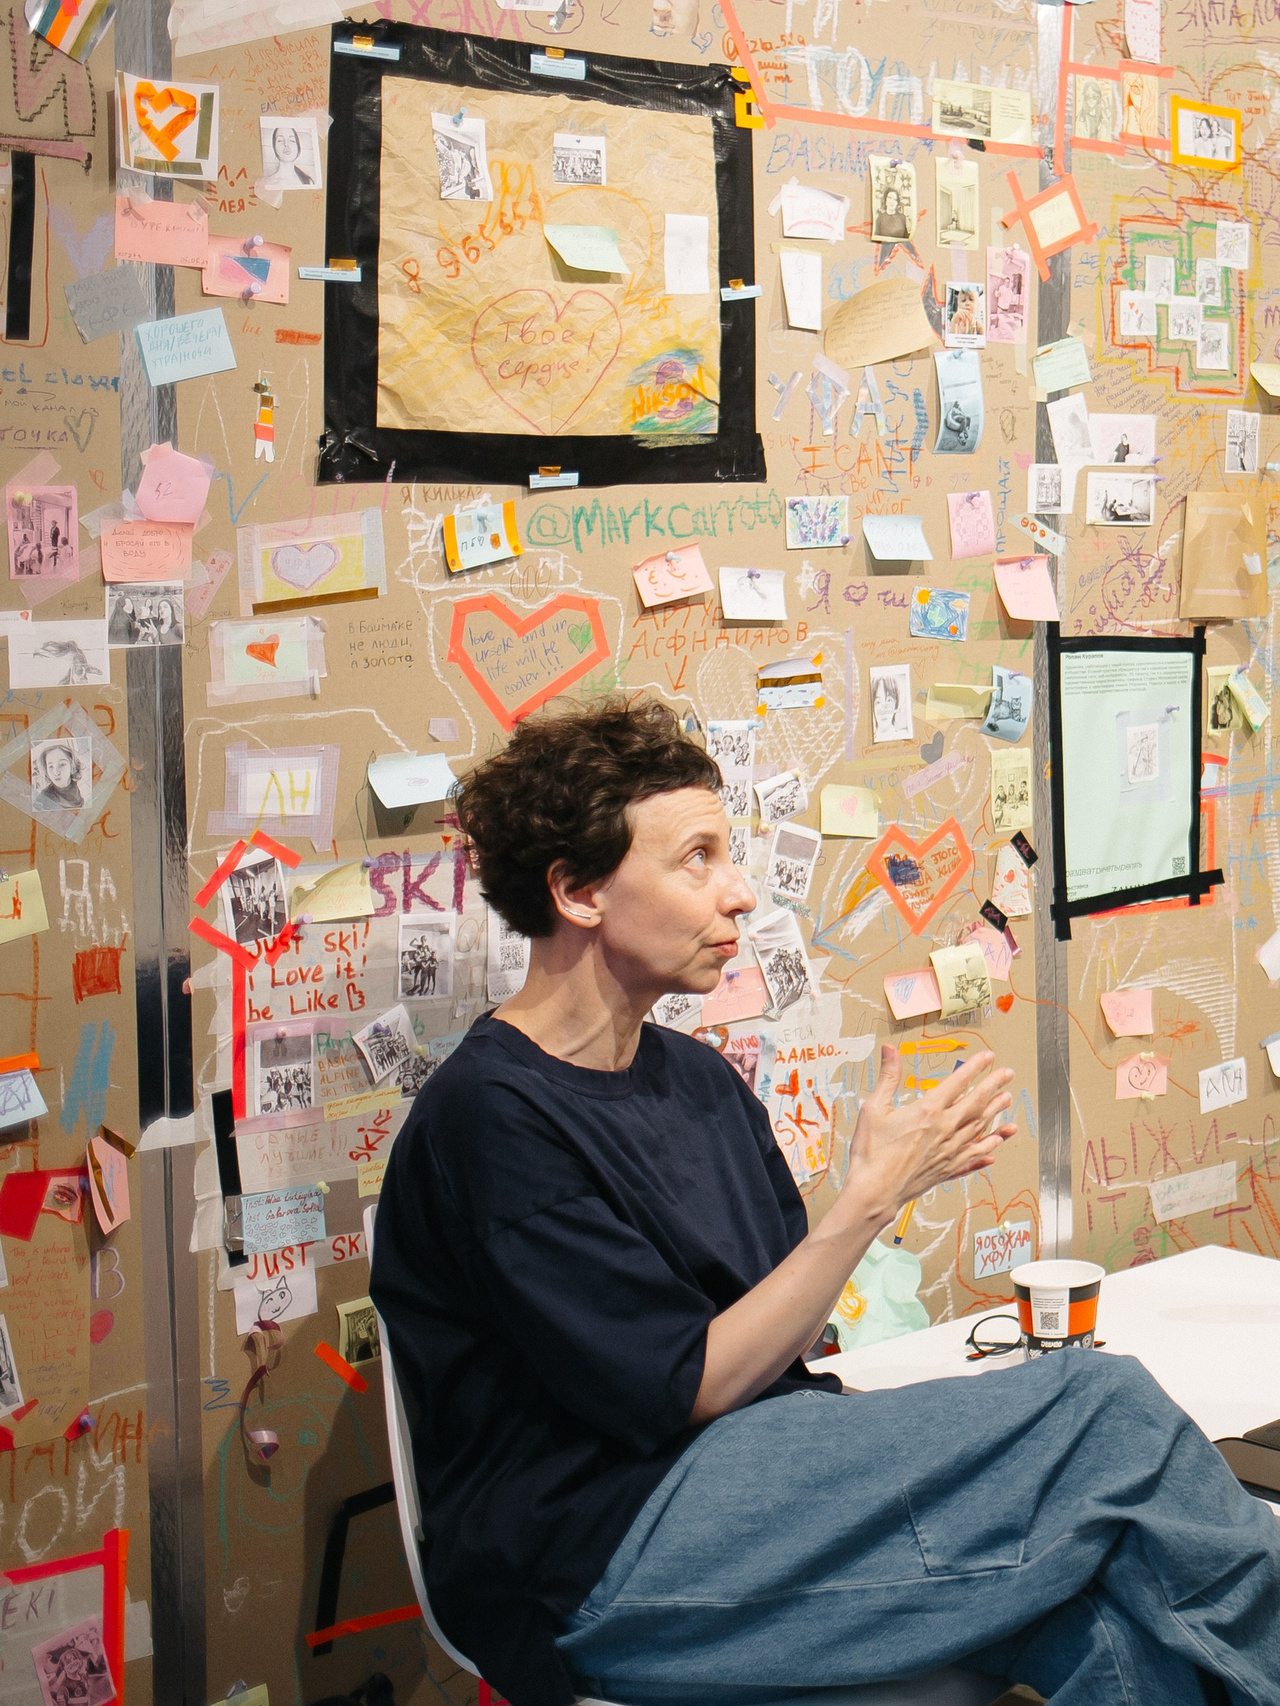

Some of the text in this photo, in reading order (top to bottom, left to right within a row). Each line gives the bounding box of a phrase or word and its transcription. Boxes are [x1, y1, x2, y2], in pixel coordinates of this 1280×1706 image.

[219, 198, 246, 213] ЛЕЯ
[146, 318, 205, 342] ХОРОШЕГО
[769, 366, 888, 438] УФА
[401, 488, 412, 504] Я
[995, 458, 1011, 554] ПРОЩАЙ
[468, 627, 495, 646] love
[542, 640, 559, 658] be
[368, 846, 468, 918] SKI
[247, 998, 274, 1023] be
[246, 1241, 316, 1281] JUST
